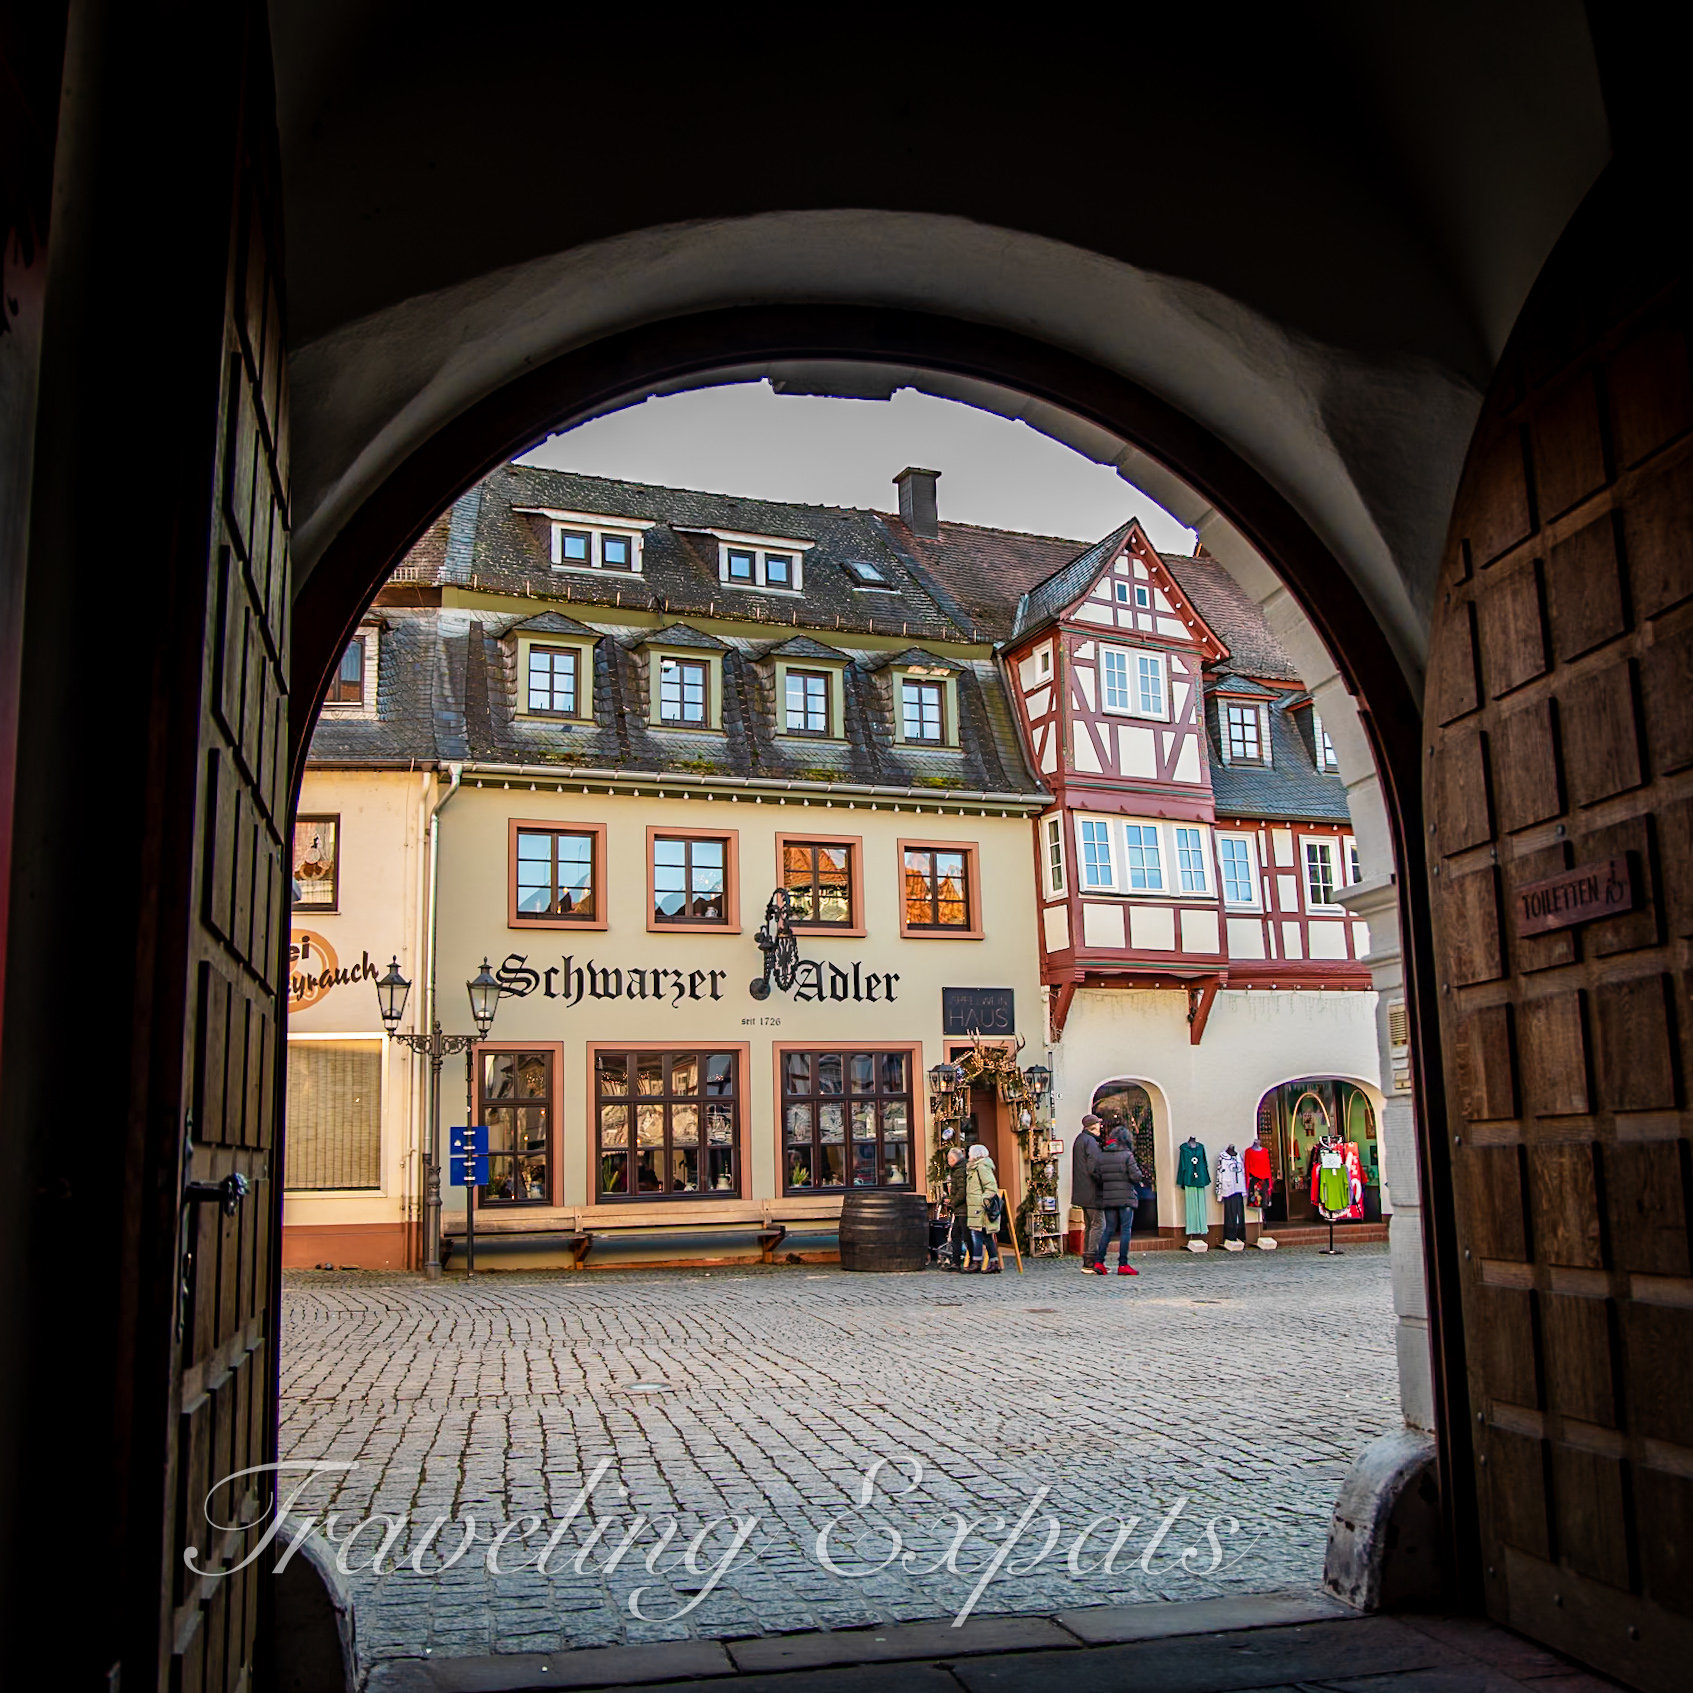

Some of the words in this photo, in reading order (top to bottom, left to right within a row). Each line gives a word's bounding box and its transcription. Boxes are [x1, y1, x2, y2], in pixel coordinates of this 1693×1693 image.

[1522, 875, 1599, 920] TOILETTEN
[287, 950, 379, 1001] yrauch
[495, 953, 728, 1009] Schwarzer
[793, 959, 901, 1003] Adler
[760, 1017, 781, 1026] 1726
[949, 1008, 1009, 1028] HAUS
